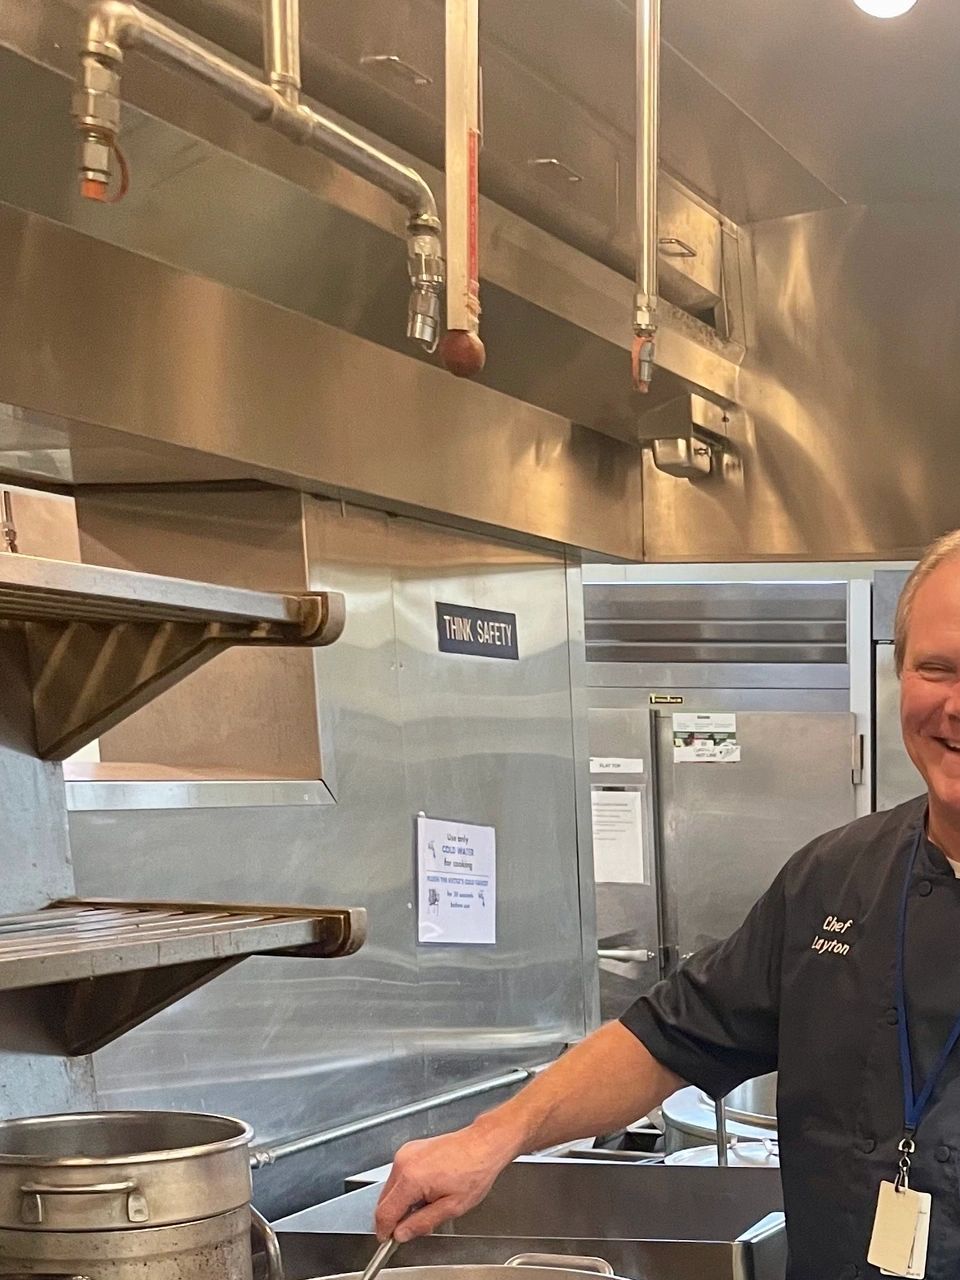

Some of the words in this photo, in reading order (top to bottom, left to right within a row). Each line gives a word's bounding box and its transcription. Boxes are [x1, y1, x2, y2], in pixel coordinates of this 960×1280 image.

[443, 615, 474, 642] THINK
[476, 620, 512, 647] SAFETY
[458, 835, 469, 845] only
[442, 845, 456, 854] COLD
[457, 848, 474, 856] WATER
[453, 860, 473, 871] cooking
[823, 915, 853, 934] Chef
[811, 935, 850, 956] Layton
